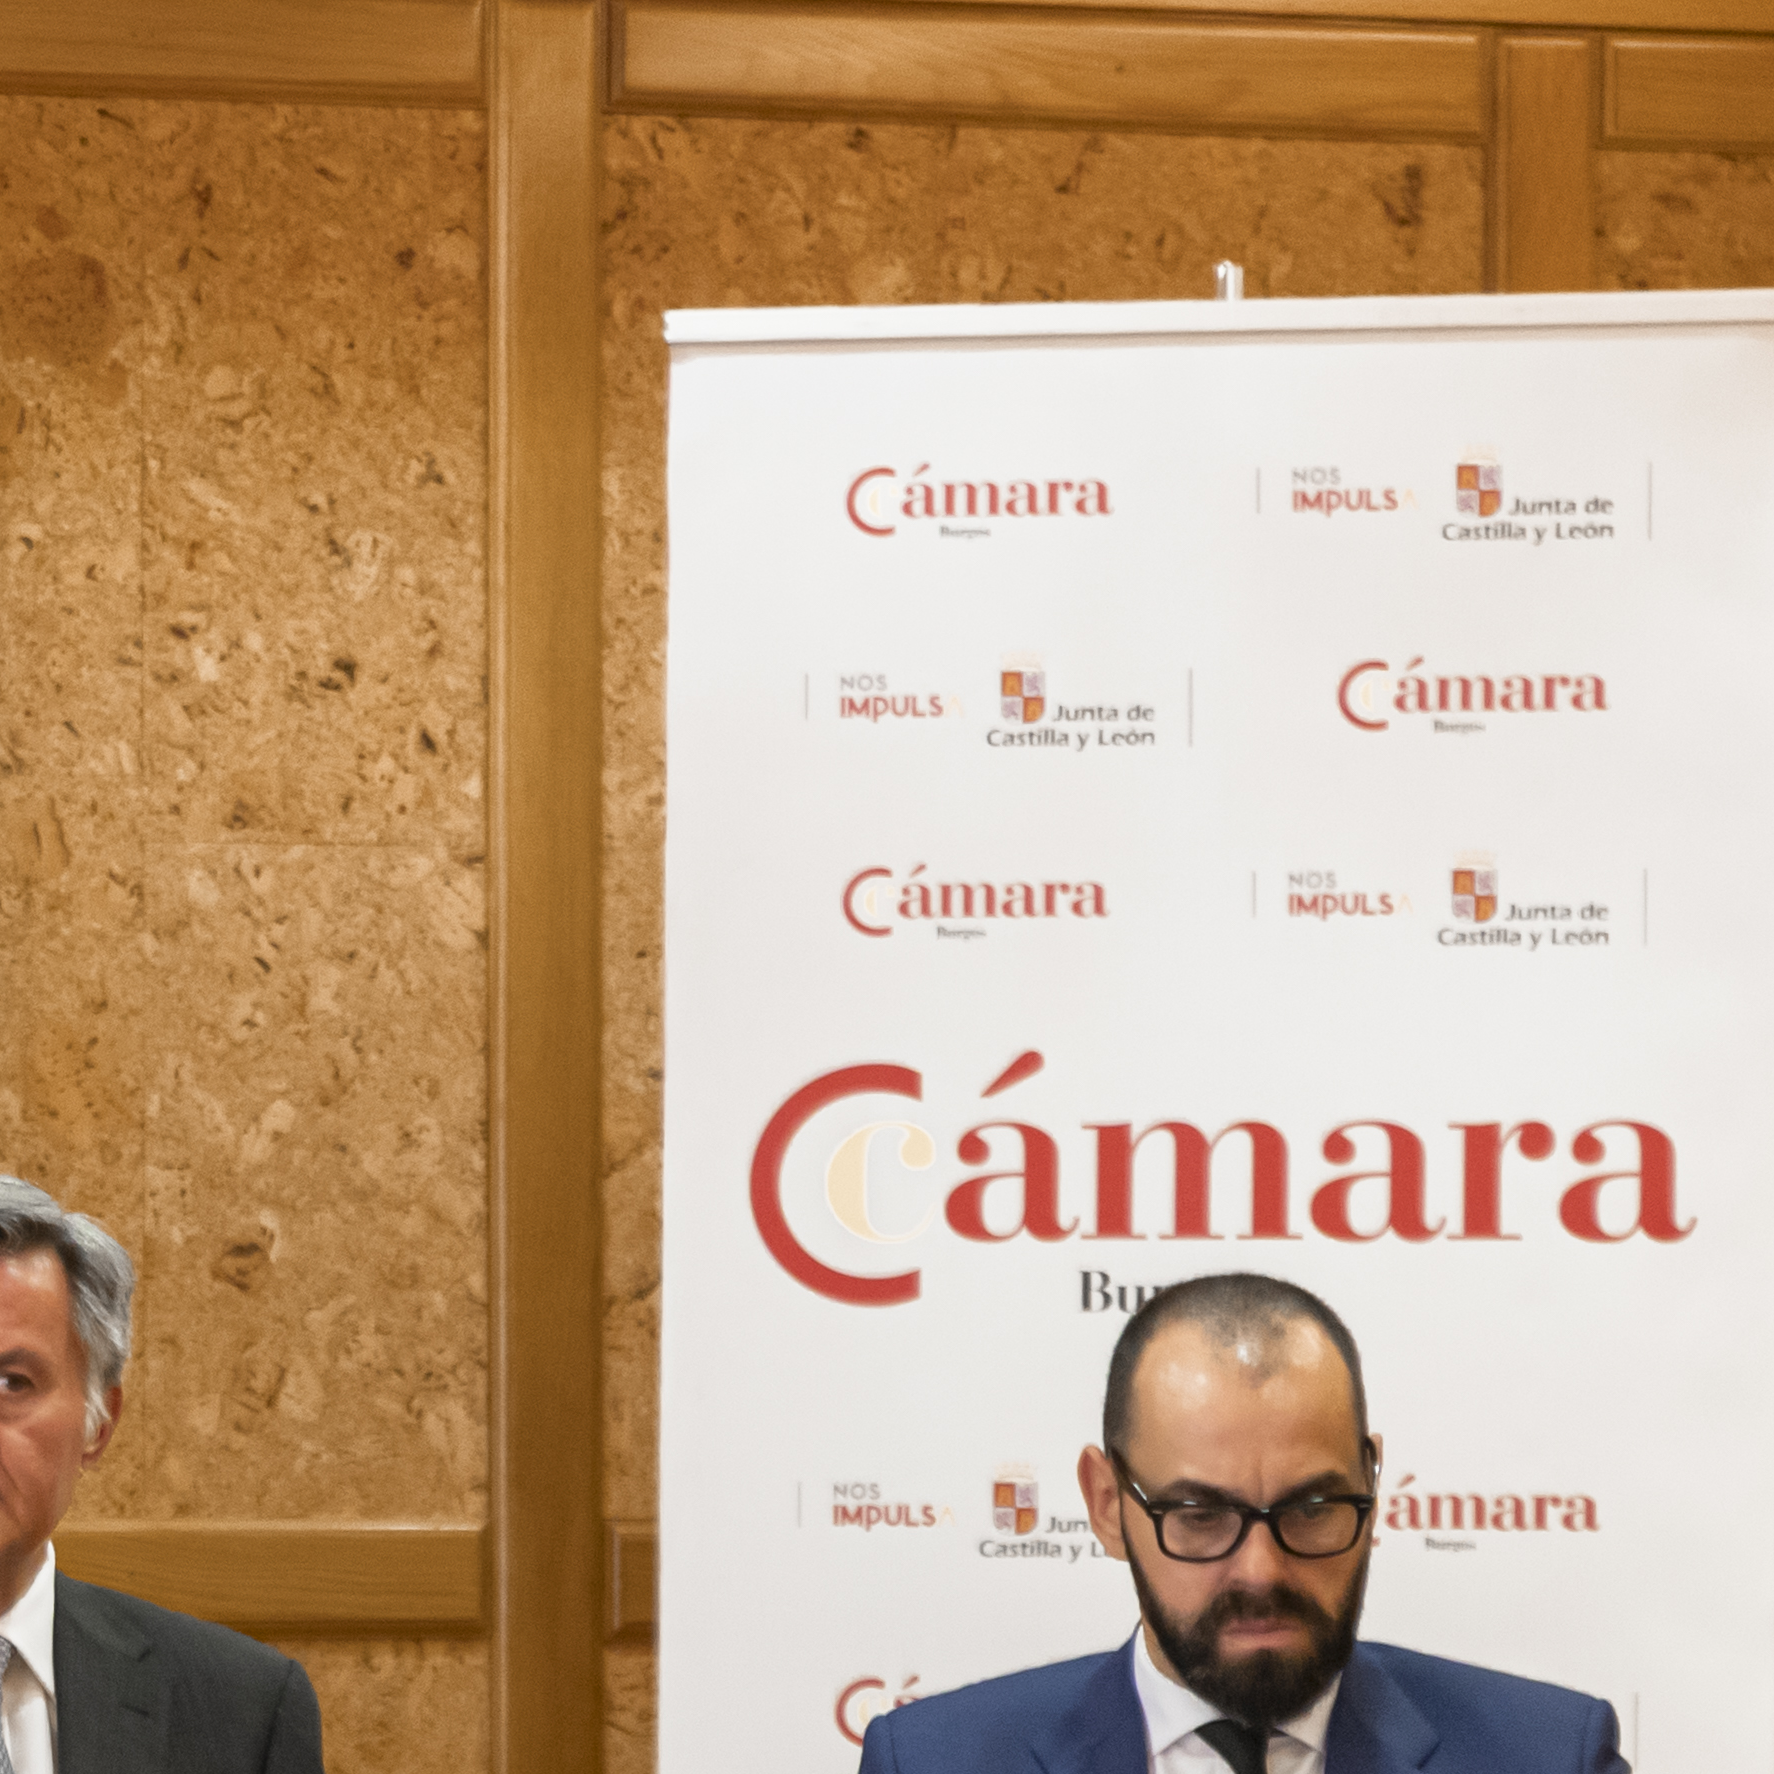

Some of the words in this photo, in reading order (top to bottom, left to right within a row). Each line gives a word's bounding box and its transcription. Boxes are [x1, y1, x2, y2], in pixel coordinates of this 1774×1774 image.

[1292, 467, 1341, 486] NOS
[845, 461, 1114, 538] Cámara
[1509, 497, 1577, 515] Junta
[1584, 496, 1613, 514] de
[1442, 521, 1527, 541] Castilla
[1534, 527, 1547, 546] y
[1555, 522, 1614, 539] León
[840, 674, 887, 692] NOS
[1336, 655, 1611, 733] Cámara
[1053, 705, 1119, 722] Junta
[1127, 704, 1154, 721] de
[986, 728, 1069, 747] Castilla
[1077, 733, 1089, 752] y
[1098, 729, 1155, 746] León
[1288, 871, 1336, 890] NOS
[841, 862, 1111, 938] Cámara
[1505, 904, 1572, 921] Junta
[1580, 903, 1608, 920] de
[1437, 928, 1522, 946] Castilla
[1529, 932, 1542, 951] y
[1551, 928, 1609, 945] León
[748, 1049, 1699, 1308] Cámara
[833, 1482, 881, 1501] NOS
[1383, 1473, 1600, 1532] ámara
[1045, 1516, 1091, 1535] Jun
[978, 1539, 1062, 1558] Castilla
[1069, 1545, 1082, 1563] y
